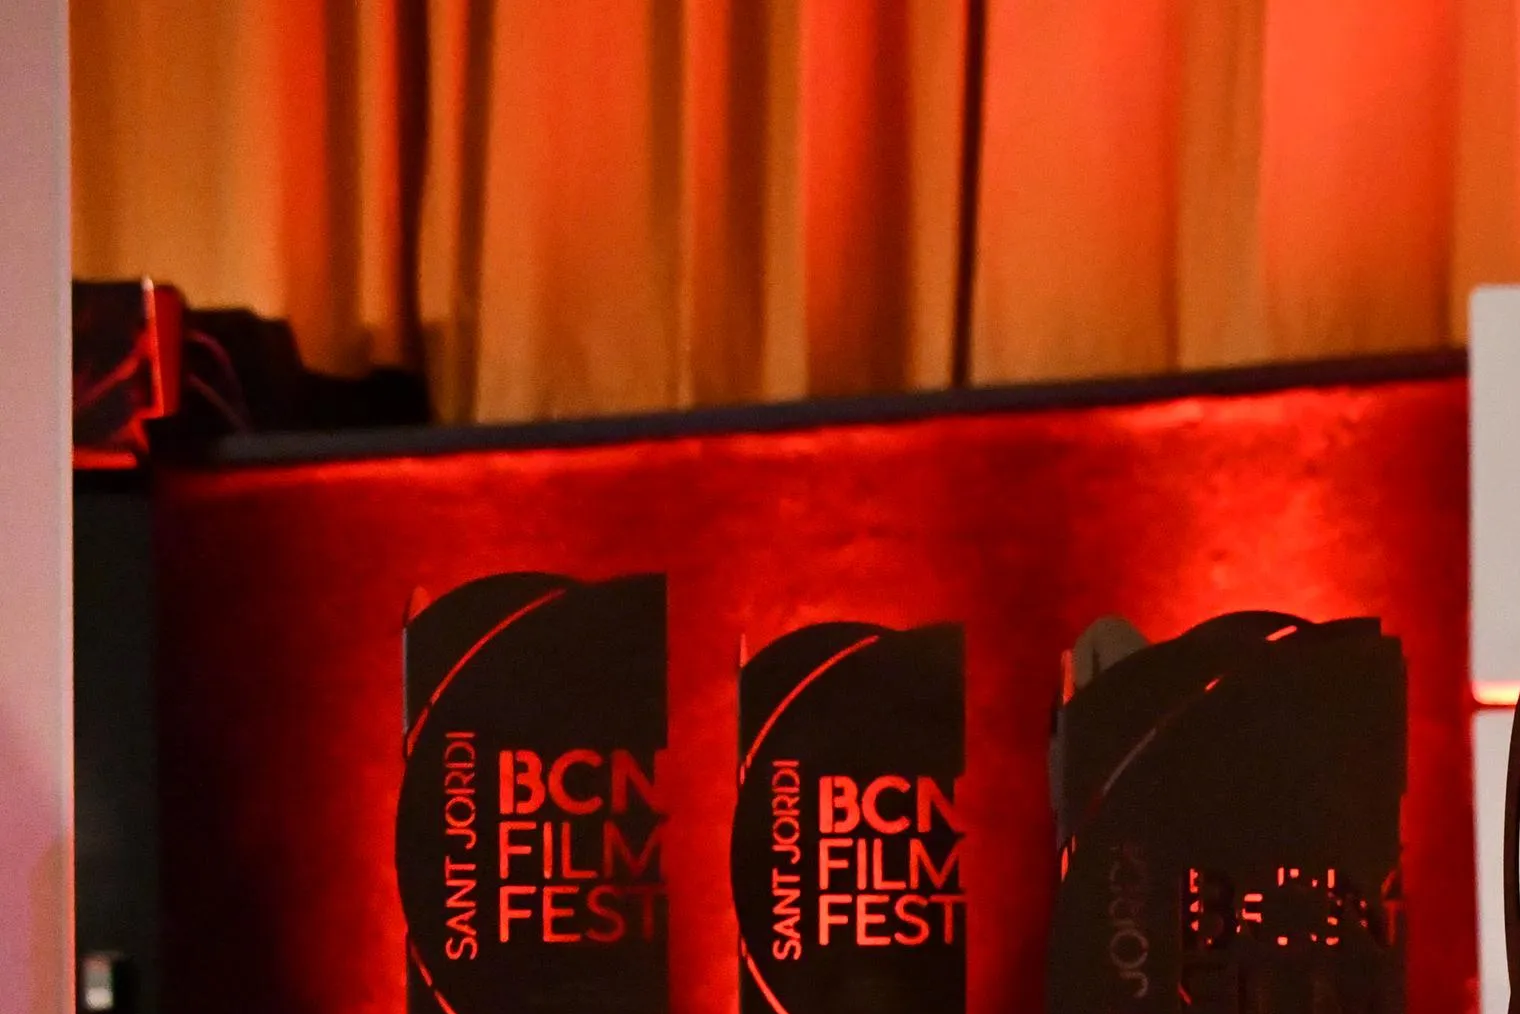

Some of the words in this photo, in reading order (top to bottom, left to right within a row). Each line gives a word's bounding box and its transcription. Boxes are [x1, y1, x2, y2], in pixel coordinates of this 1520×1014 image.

[444, 731, 477, 849] JORDI
[499, 748, 668, 815] BCN
[772, 759, 800, 863] JORDI
[818, 774, 966, 834] BCN
[499, 821, 668, 879] FILM
[818, 838, 965, 889] FILM
[444, 854, 479, 961] SANT
[499, 886, 669, 942] FEST
[772, 867, 801, 961] SANT
[818, 895, 967, 946] FEST
